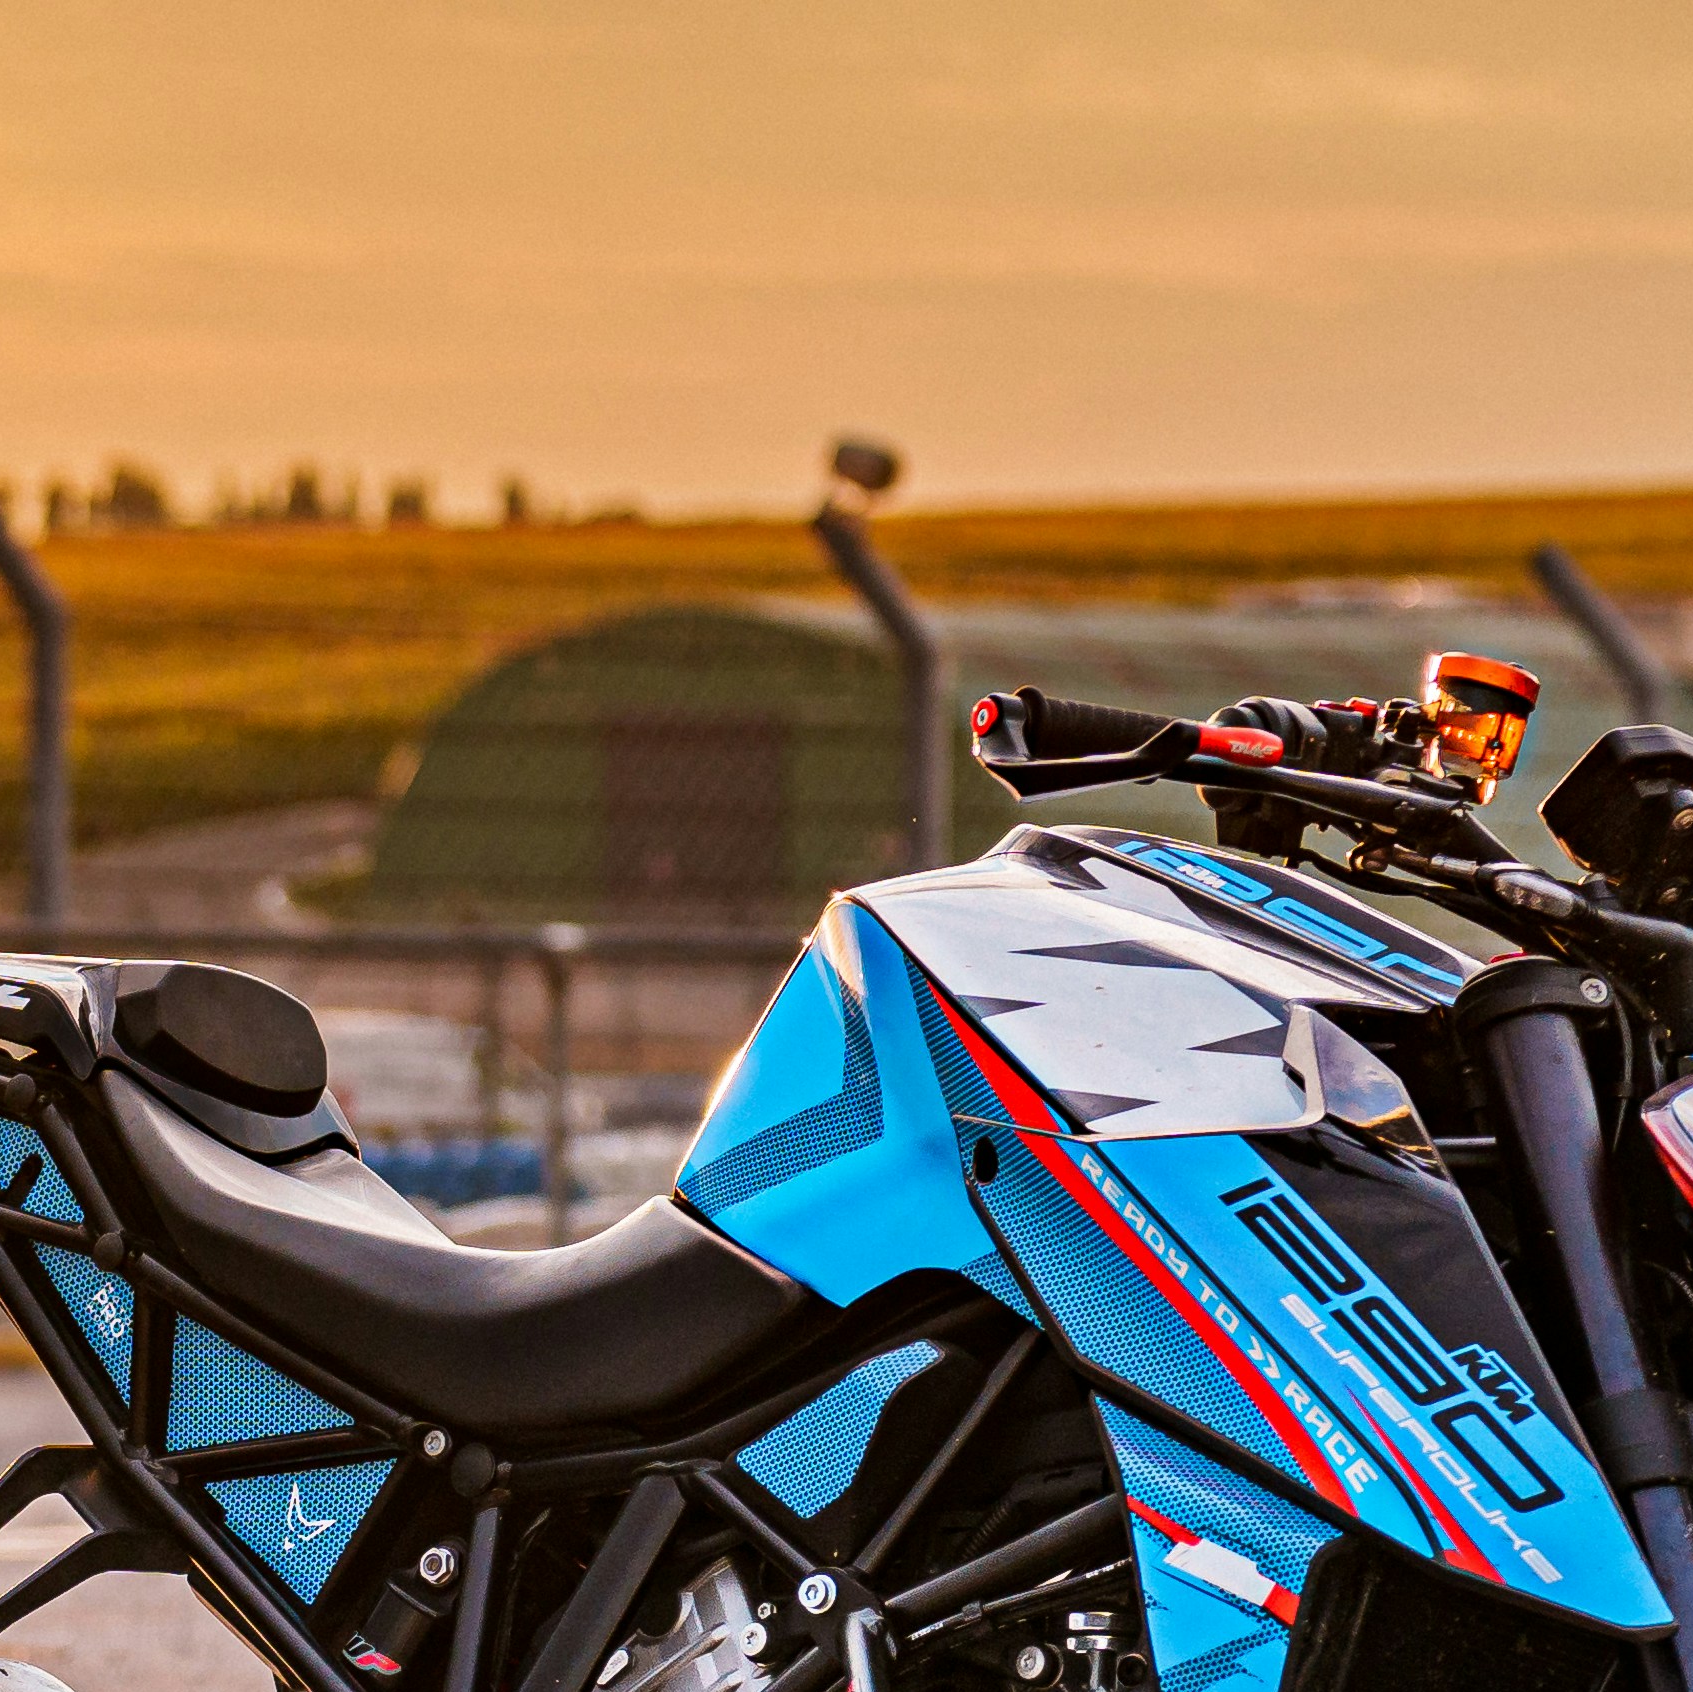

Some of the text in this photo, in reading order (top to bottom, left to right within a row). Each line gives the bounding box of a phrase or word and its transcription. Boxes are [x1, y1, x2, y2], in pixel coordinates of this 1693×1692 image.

[1176, 863, 1227, 891] KTM
[93, 1288, 125, 1338] PRO
[1080, 1152, 1379, 1493] READY TO RACE
[1217, 1176, 1565, 1514] 1290
[1449, 1344, 1537, 1426] KTM
